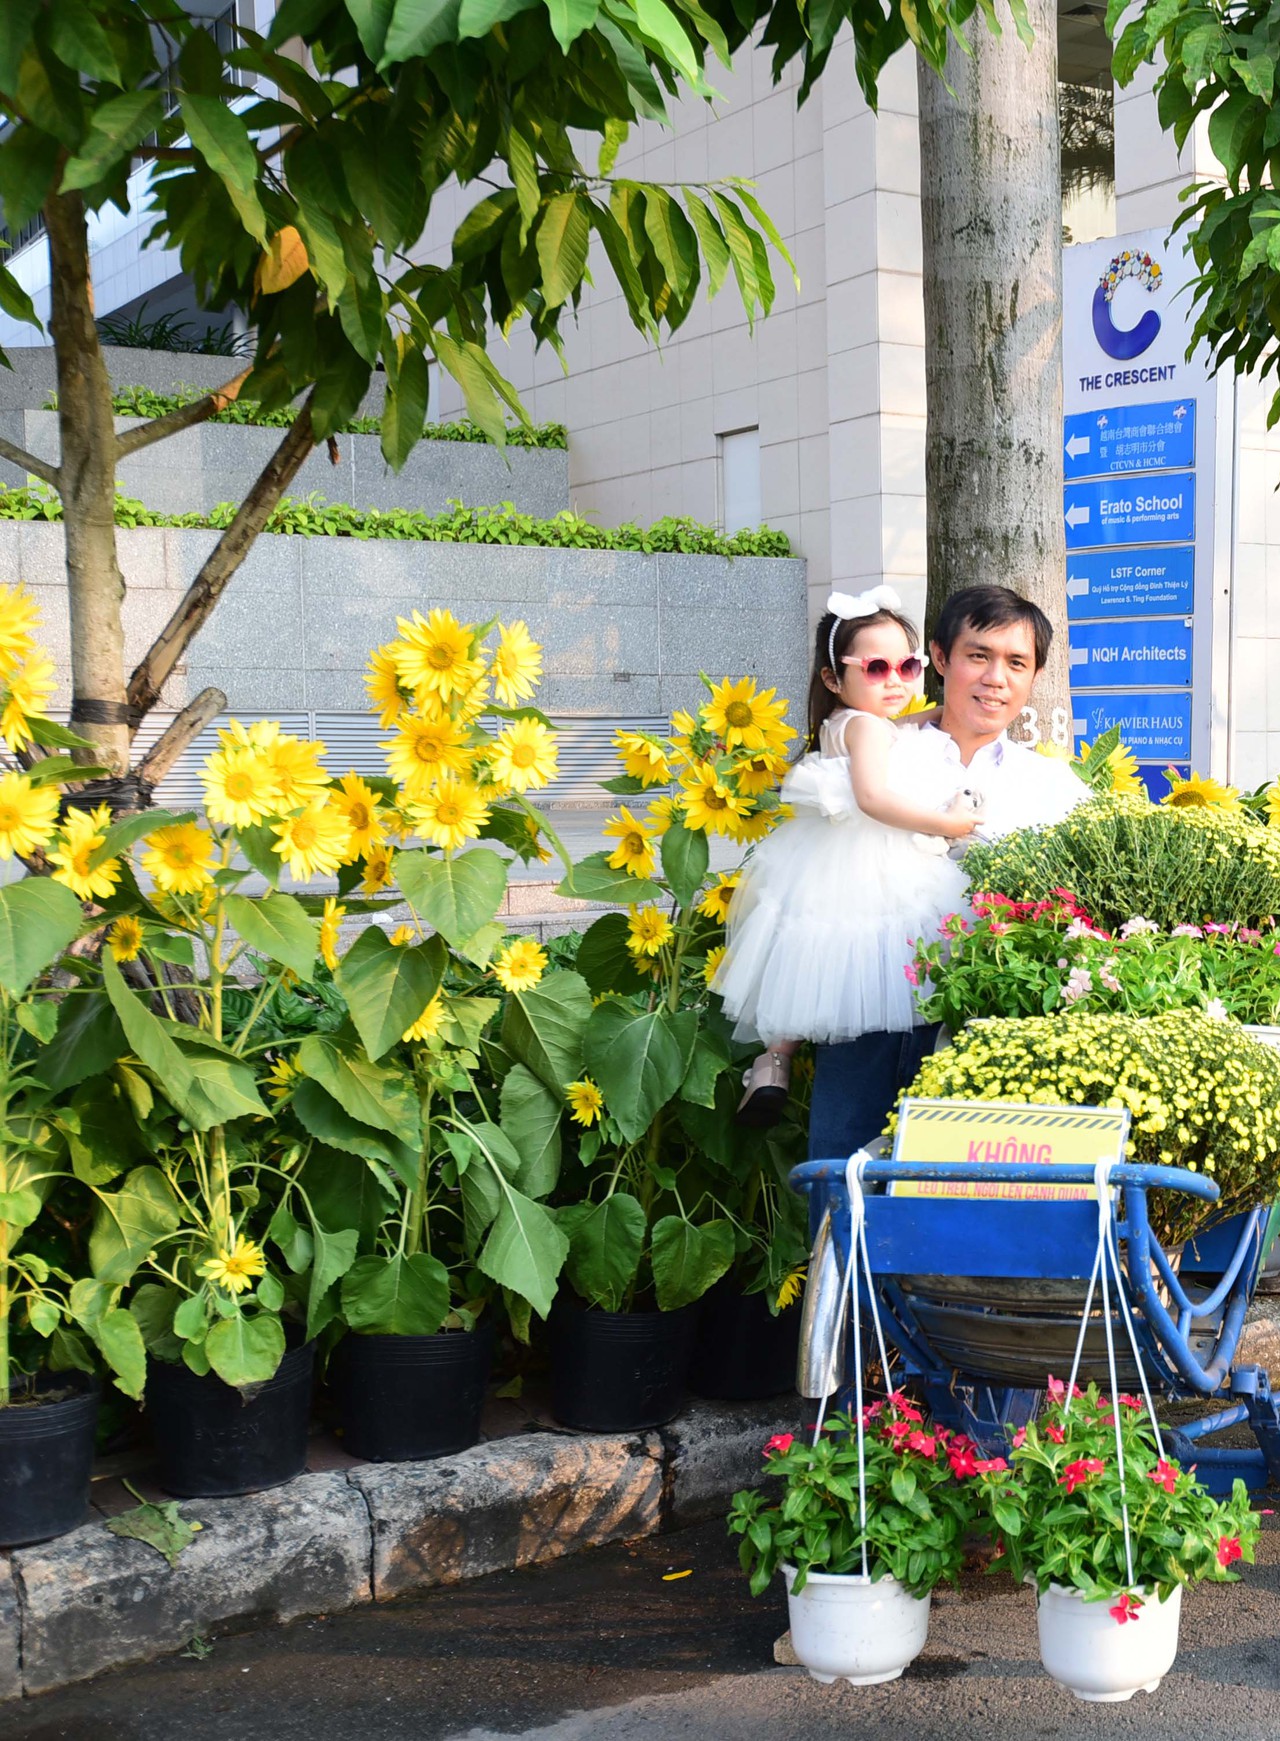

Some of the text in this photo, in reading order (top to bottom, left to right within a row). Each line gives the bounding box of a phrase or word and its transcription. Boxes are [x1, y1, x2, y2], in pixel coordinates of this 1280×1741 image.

[1079, 365, 1176, 392] THE CRESCENT
[1110, 456, 1167, 471] CTCVN & HCMC
[1100, 493, 1183, 515] Erato School
[1101, 512, 1179, 525] of music & performing arts
[1110, 566, 1166, 579] LSTF Corner
[1101, 597, 1125, 605] Lawrence
[1133, 595, 1145, 604] Ting
[1145, 593, 1177, 602] Foundation
[1092, 646, 1187, 663] NQH Architects
[1128, 736, 1148, 745] PIANO
[1148, 736, 1153, 744] &
[967, 1136, 1053, 1165] KHÔNG
